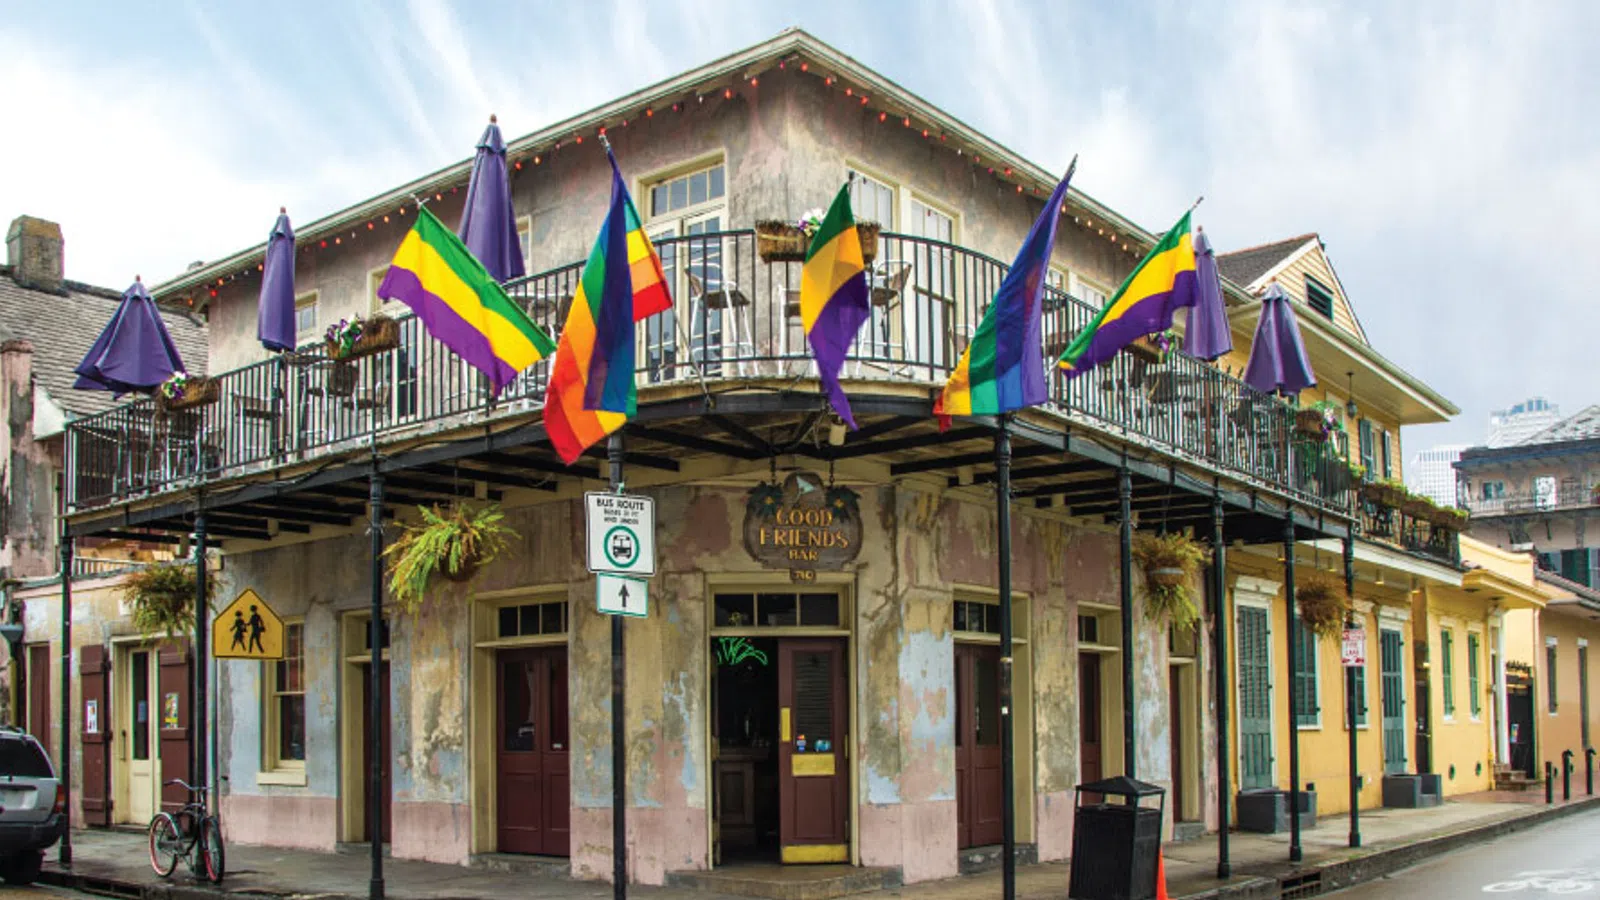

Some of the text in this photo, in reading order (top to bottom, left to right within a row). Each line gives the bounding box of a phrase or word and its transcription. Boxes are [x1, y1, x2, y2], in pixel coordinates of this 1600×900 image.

[597, 498, 644, 510] BUS ROUTE
[776, 508, 832, 526] GOOD
[760, 527, 848, 548] FRIENDS
[789, 549, 817, 560] BAR
